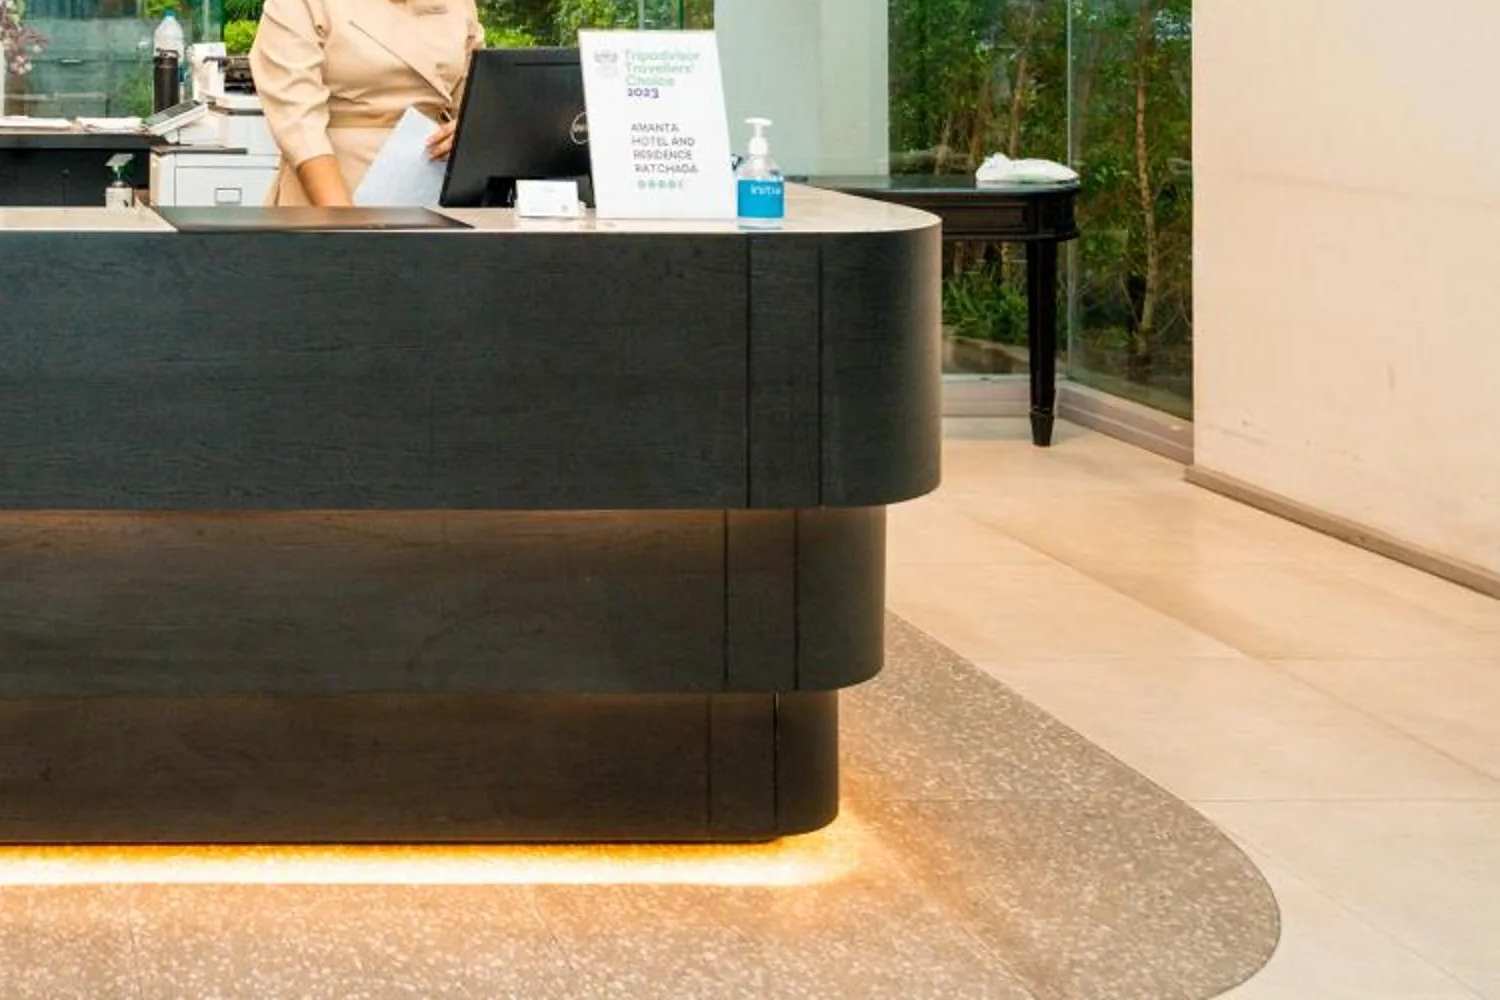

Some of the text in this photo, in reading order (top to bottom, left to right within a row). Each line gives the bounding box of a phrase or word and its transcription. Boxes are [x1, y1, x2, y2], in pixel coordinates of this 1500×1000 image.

[626, 75, 677, 87] Choice
[627, 87, 660, 99] 2023
[631, 135, 696, 147] HOTEL AND
[633, 149, 692, 160] RESIDENCE
